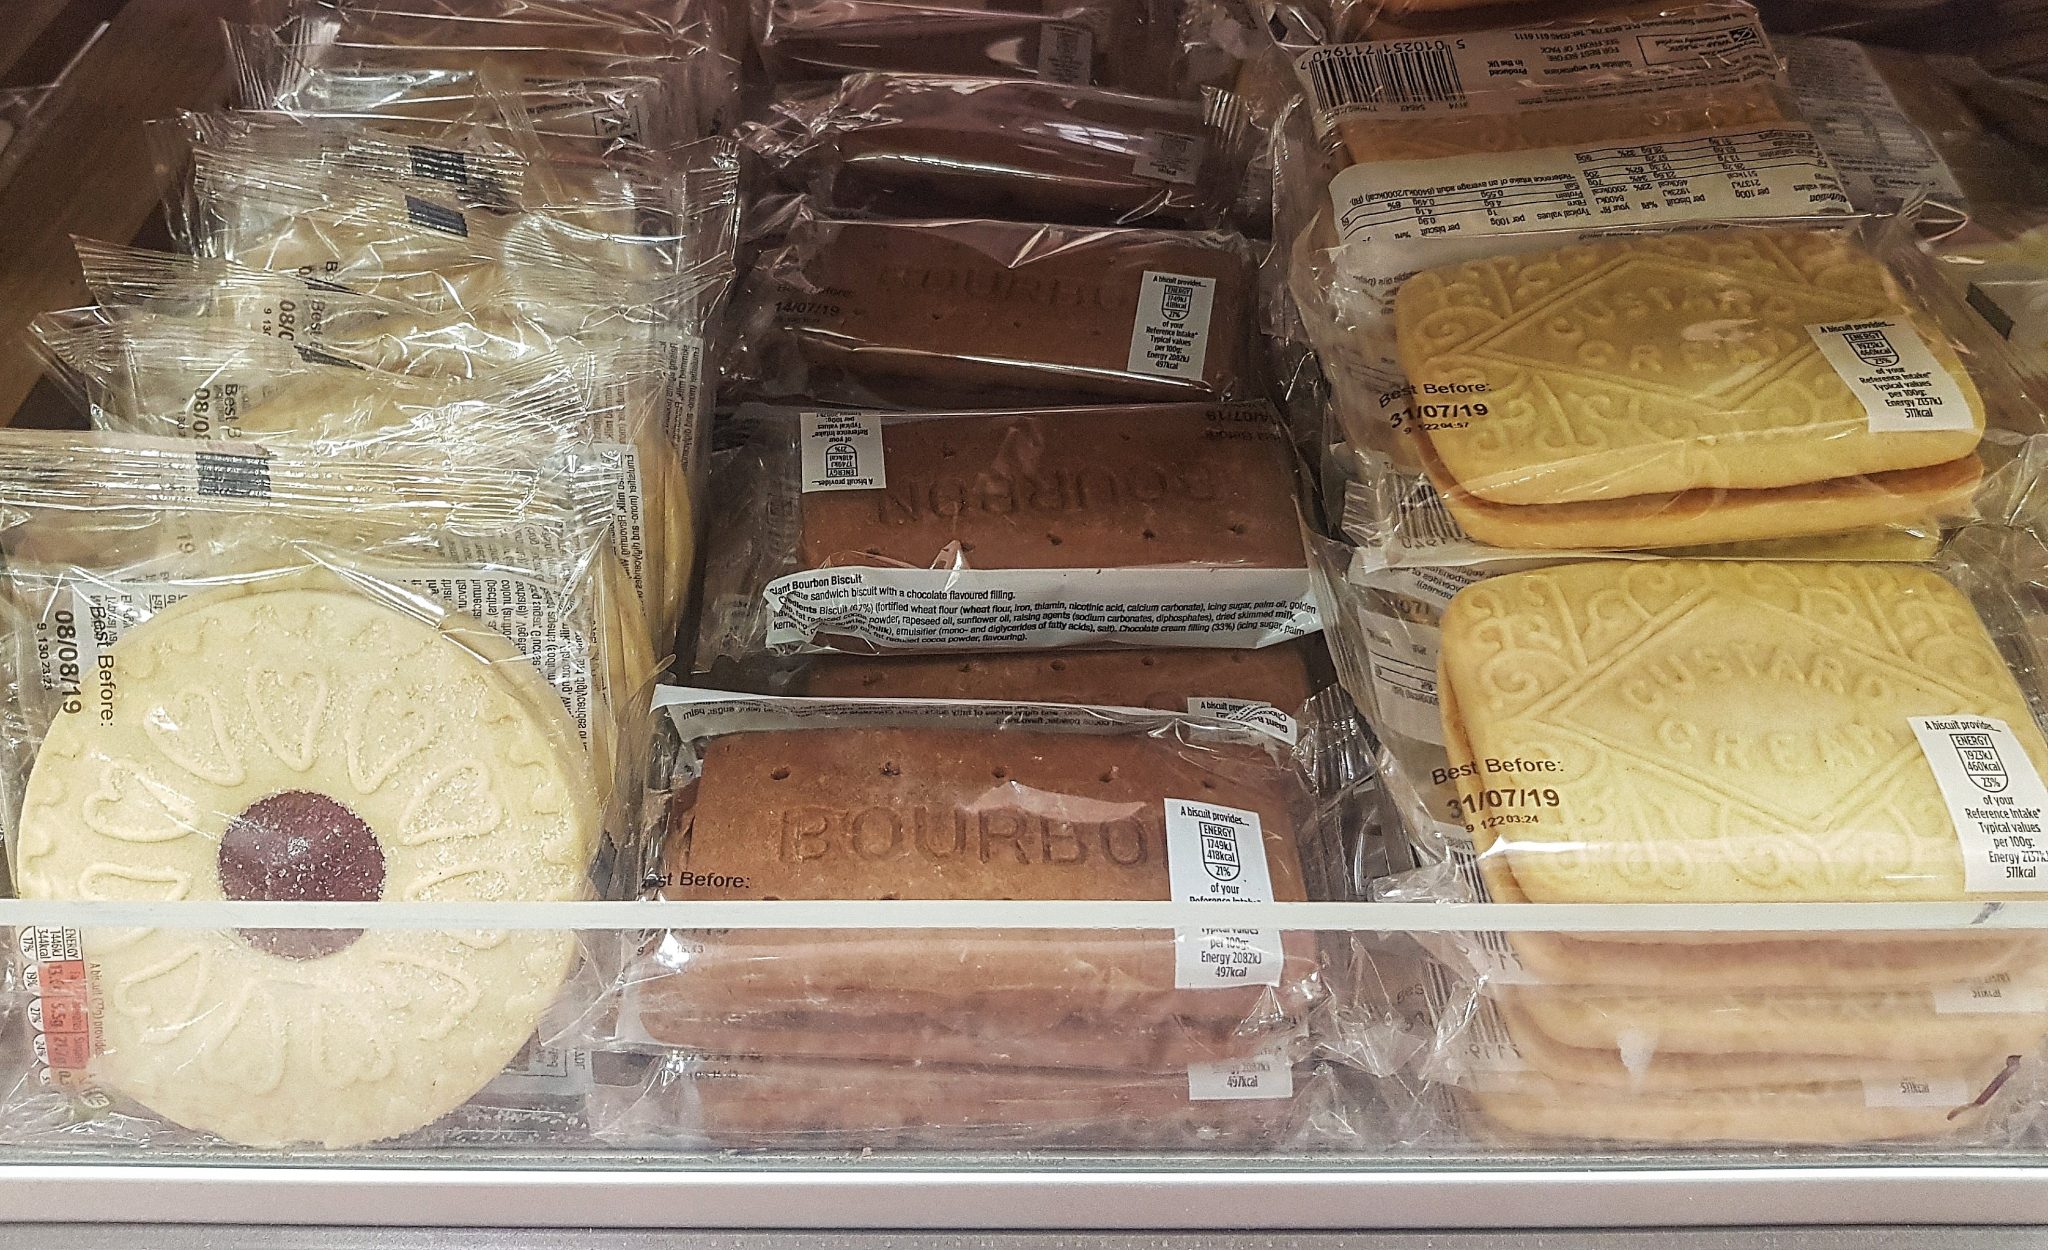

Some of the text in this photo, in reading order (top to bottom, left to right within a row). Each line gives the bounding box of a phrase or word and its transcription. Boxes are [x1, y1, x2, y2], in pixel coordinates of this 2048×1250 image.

[1146, 326, 1175, 336] Reference
[1147, 351, 1168, 360] Energy
[1859, 374, 1901, 384] Reference
[1873, 380, 1932, 392] Typical values
[1378, 383, 1493, 408] Best Before:
[1885, 399, 1916, 408] Energy
[1389, 403, 1489, 429] 31/07/19
[1904, 408, 1933, 418] 511kcal
[792, 574, 863, 590] Bourbon Biscuit
[810, 588, 850, 600] sandwich
[851, 586, 877, 598] biscuit
[879, 586, 897, 597] with
[906, 589, 948, 600] chocolate
[949, 590, 988, 601] flavoured
[990, 590, 1015, 602] filling.
[819, 604, 847, 615] Biscuit
[875, 601, 908, 613] (fortified
[910, 603, 937, 614] wheat
[938, 603, 958, 614] flour
[960, 602, 990, 616] (wheat
[992, 603, 1013, 615] flour,
[1069, 601, 1104, 612] nicotinic
[1105, 602, 1125, 613] acid,
[1127, 602, 1159, 612] calcium
[1289, 601, 1316, 614] golden
[869, 614, 901, 625] powder,
[902, 615, 941, 626] rapeseed
[957, 614, 998, 625] sunflower
[1013, 612, 1041, 623] raising
[1042, 611, 1070, 621] agents
[1215, 611, 1236, 621] dried
[1237, 610, 1274, 620] skimmed
[896, 626, 936, 636] emulsifier
[970, 624, 986, 634] and
[988, 622, 1036, 634] diglycerides
[54, 610, 82, 715] 08/08/19
[89, 606, 117, 727] Best Before:
[1932, 720, 1959, 730] biscuit
[1956, 735, 1989, 746] ENERGY
[1965, 750, 1993, 760] 1923kJ
[1431, 758, 1564, 785] Best Before:
[1967, 761, 2001, 772] 460kcal
[1981, 777, 2001, 788] 23%
[1446, 788, 1560, 819] 31/07/19
[1983, 794, 2015, 807] of your
[1187, 807, 1212, 820] biscuit
[1965, 808, 2009, 819] Reference
[1204, 824, 1233, 838] ENERGY
[1978, 822, 2041, 834] Typical values
[1207, 838, 1232, 852] 1749kJ
[1993, 836, 2035, 849] per 100g:
[1207, 850, 1236, 862] 418kcal
[1988, 851, 2020, 864] Energy
[1215, 865, 1231, 877] 21%
[2006, 866, 2037, 878] 511kcal
[680, 871, 750, 889] Before:
[1210, 882, 1240, 896] of your
[37, 929, 51, 959] 344kcal
[50, 930, 63, 957] 1446kJ
[65, 928, 79, 959] ENERGY
[1201, 952, 1262, 965] Energy 2082kJ
[1215, 967, 1248, 978] 497kcal
